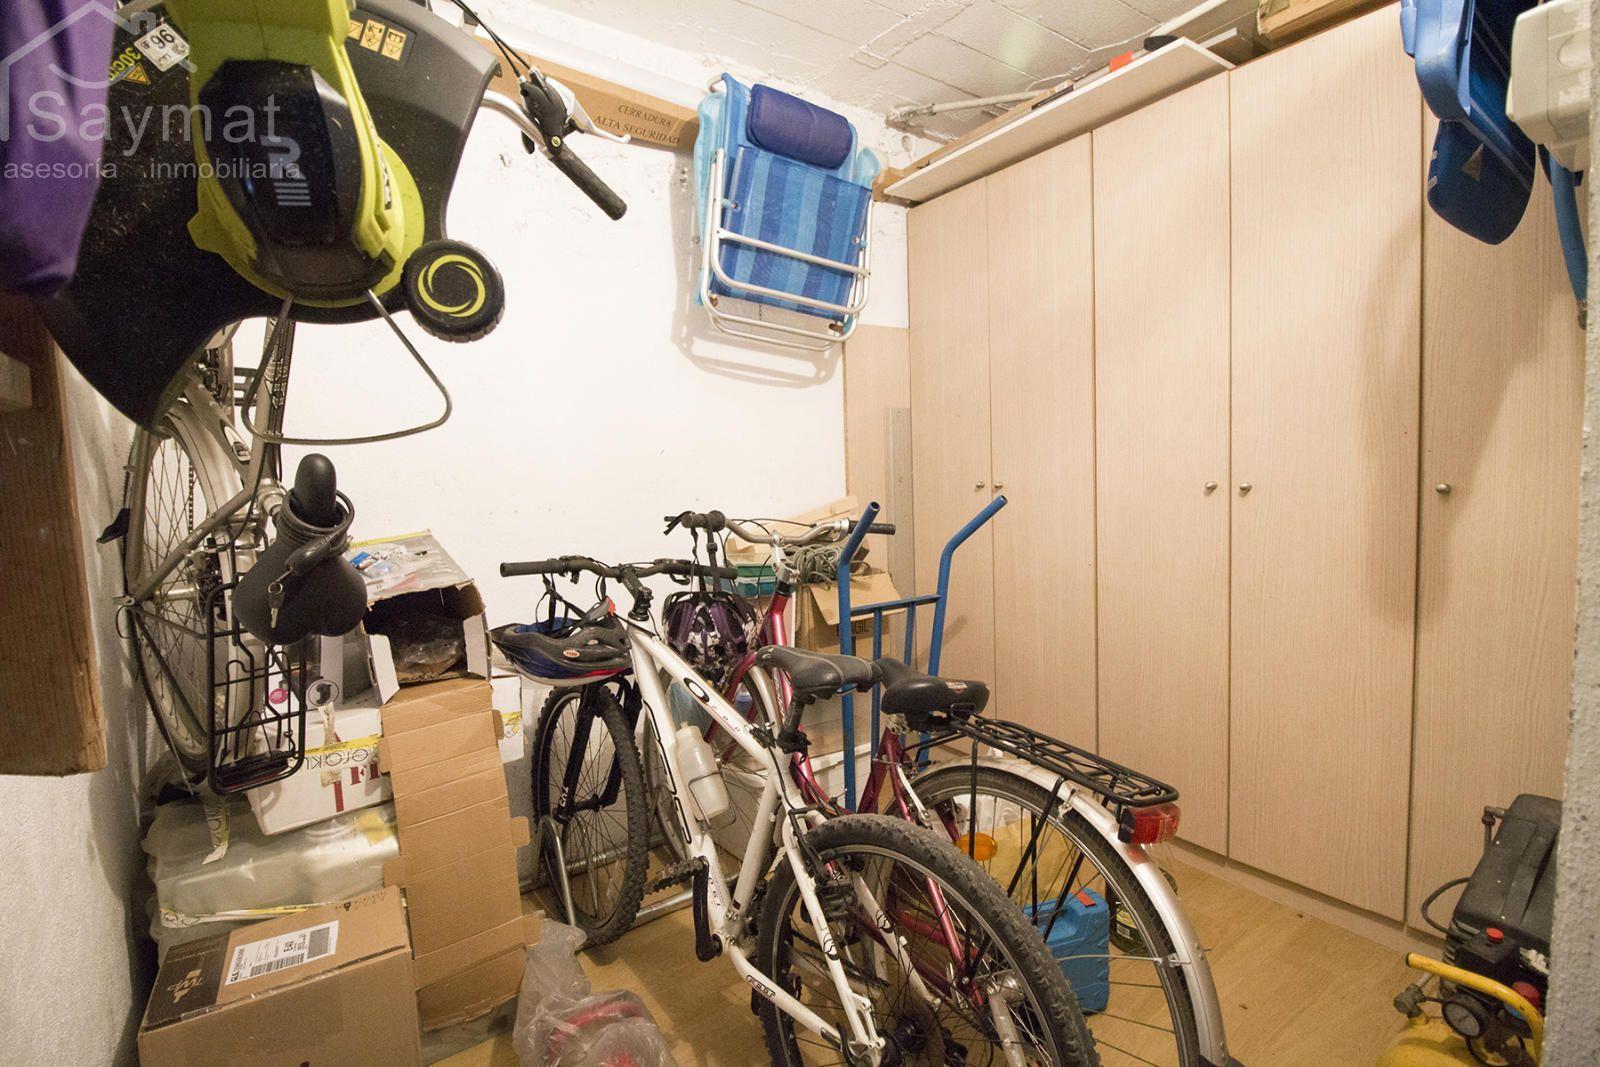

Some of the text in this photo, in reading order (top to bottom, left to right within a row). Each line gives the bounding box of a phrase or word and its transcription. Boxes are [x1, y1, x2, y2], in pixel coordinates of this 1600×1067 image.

[617, 104, 672, 128] CERRADURA
[593, 116, 680, 144] ALTA SEGURIDAD
